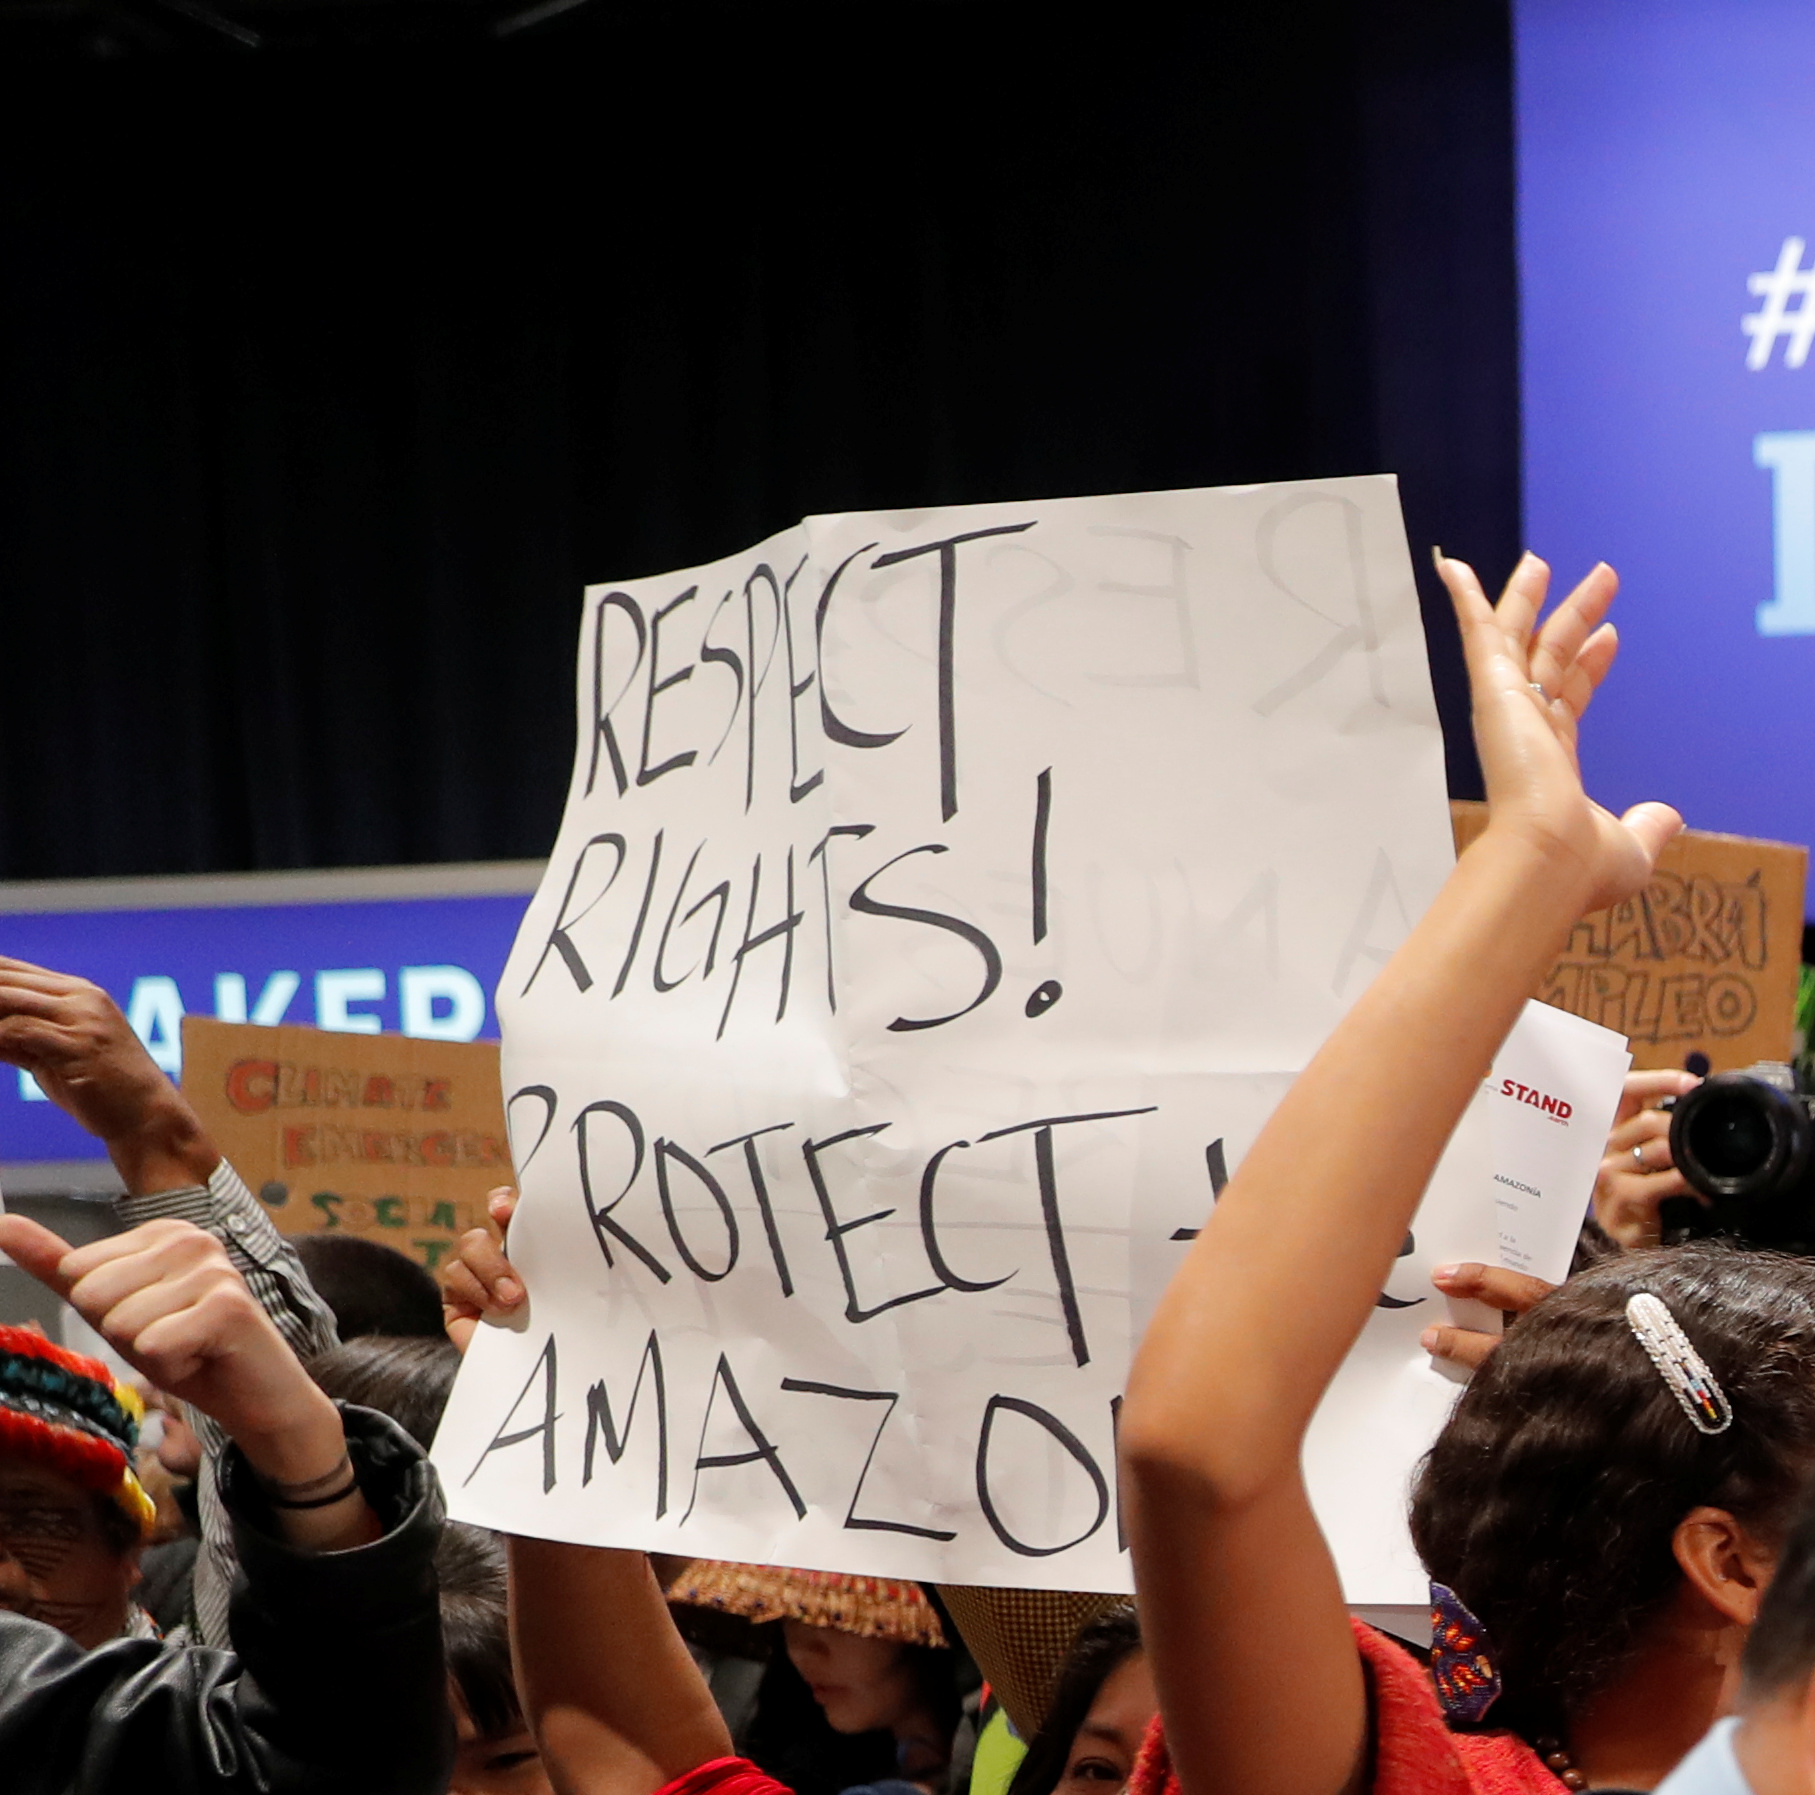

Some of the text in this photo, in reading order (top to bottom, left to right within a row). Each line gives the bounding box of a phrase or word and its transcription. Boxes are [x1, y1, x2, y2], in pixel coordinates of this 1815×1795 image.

[581, 520, 1037, 822] RESPECT
[519, 765, 1064, 1043] RIGHTS!
[16, 962, 487, 1102] AKER
[1501, 1079, 1573, 1120] STAND
[1493, 1173, 1542, 1199] AMAZONÍA
